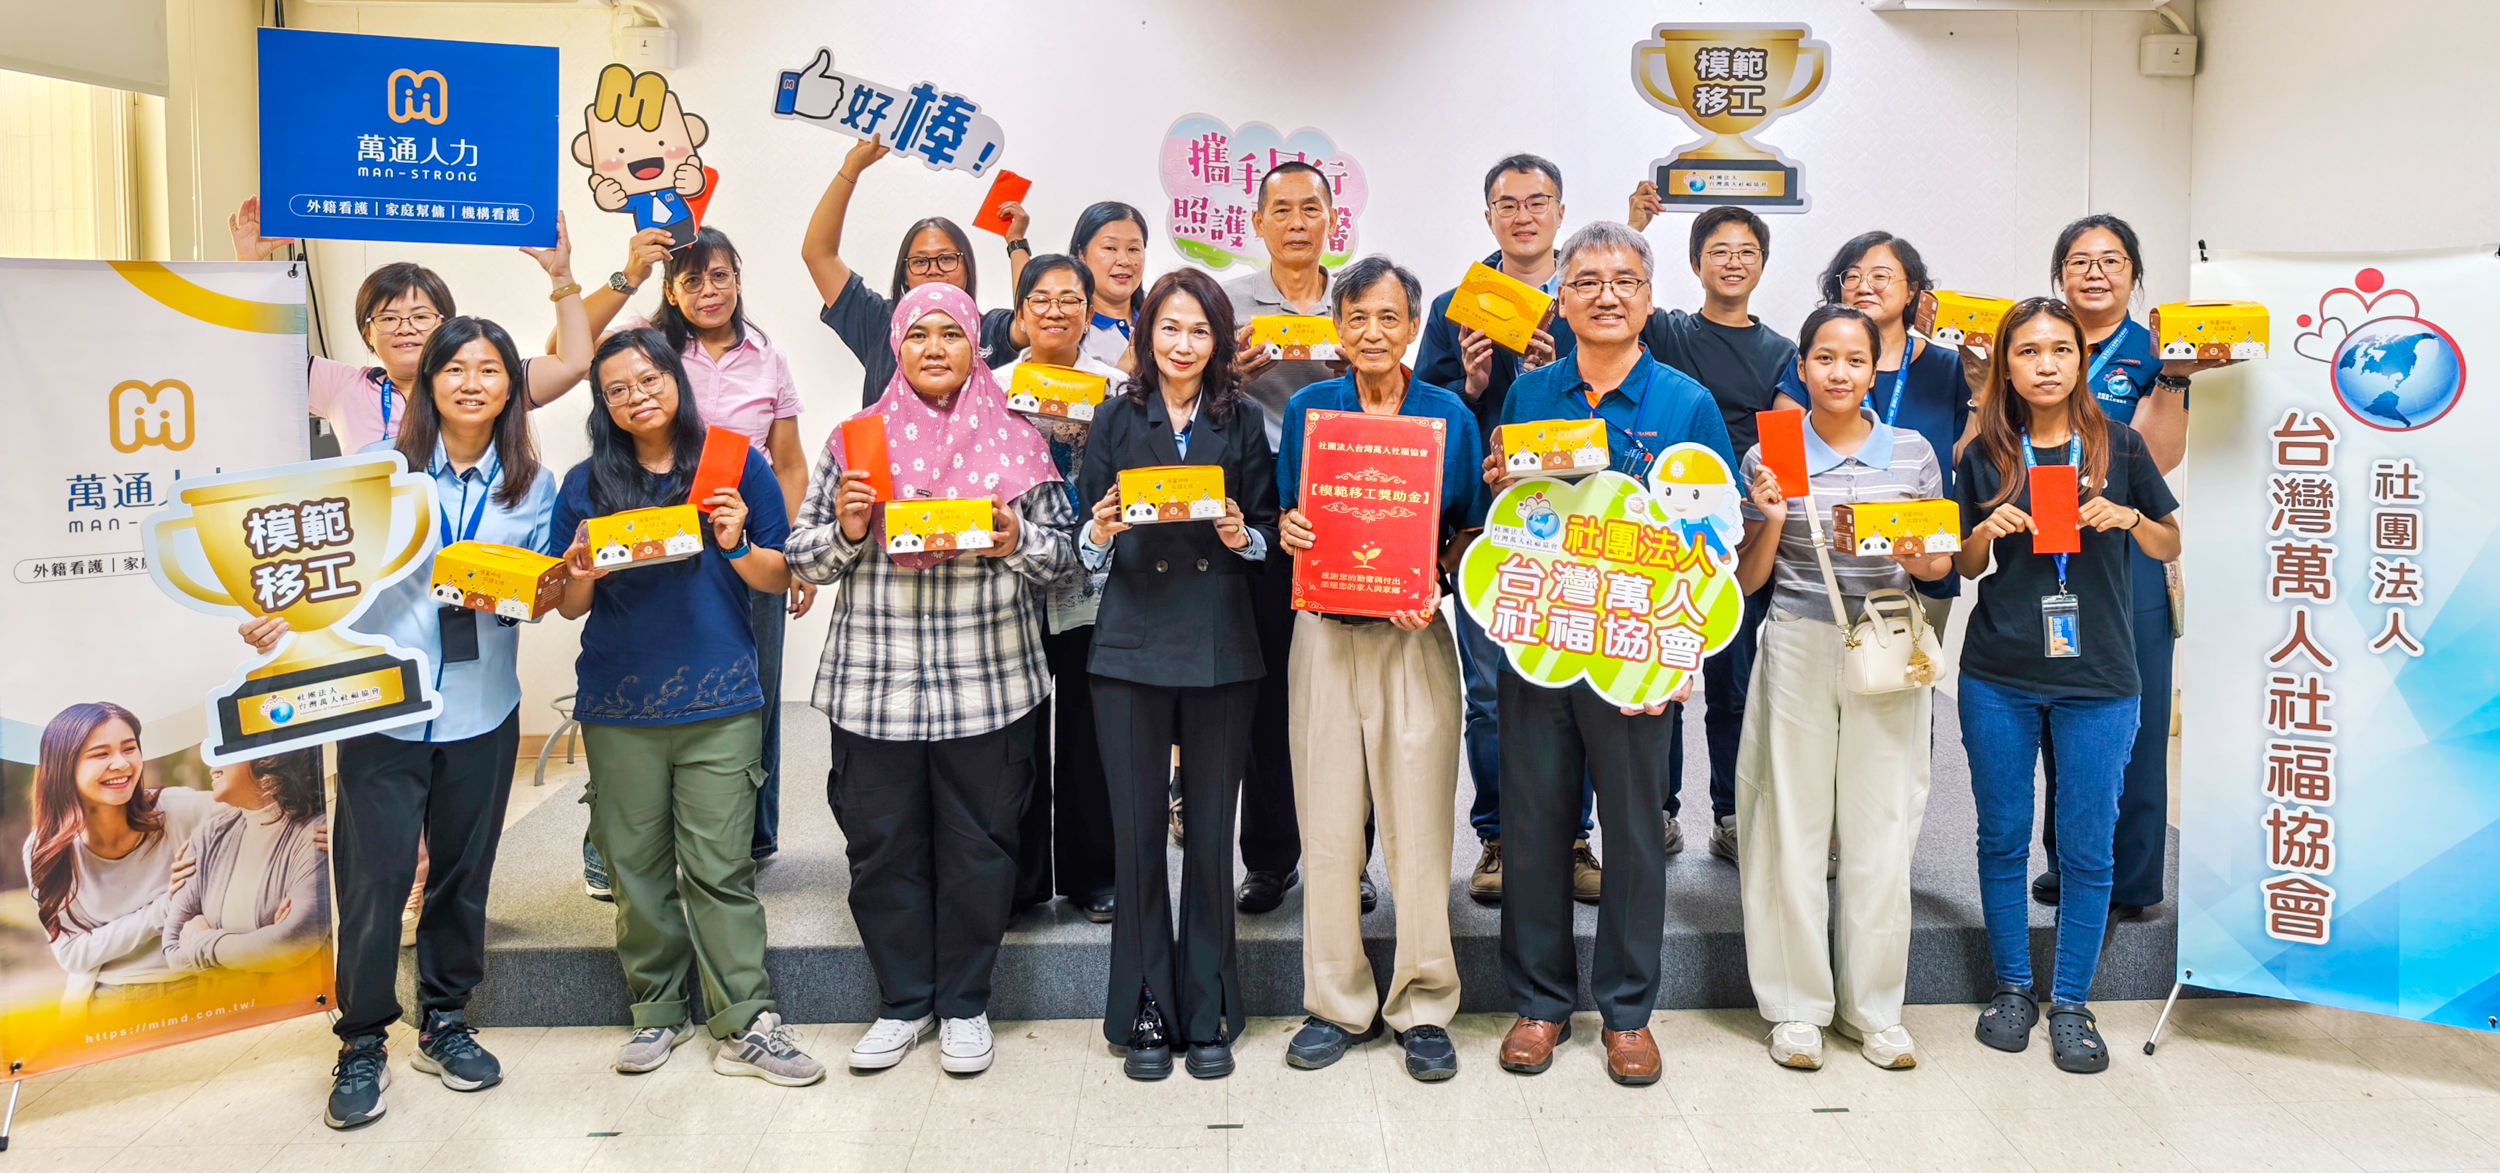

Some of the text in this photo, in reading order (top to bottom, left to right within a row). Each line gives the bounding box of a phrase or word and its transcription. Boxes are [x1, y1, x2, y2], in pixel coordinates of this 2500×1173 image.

[1697, 50, 1766, 79] 模範
[1696, 86, 1765, 115] 移工
[357, 134, 478, 167] 萬通人力
[307, 199, 521, 222] 外籍看護 家庭幫傭 機構看護
[1318, 441, 1429, 458] 社團法人台灣萬人社福協會
[248, 502, 350, 556] 模範
[1494, 525, 1526, 537] 社團法人
[1565, 516, 1715, 576] 社團法人
[2373, 463, 2420, 651] 社團法人
[33, 559, 104, 579] 外籍看護
[255, 556, 357, 609] 移工
[1498, 555, 1705, 625] 台灣萬人
[1492, 600, 1706, 669] 社福協會
[2266, 412, 2335, 939] 台灣萬人社福協會
[297, 687, 337, 701] 社團法人
[298, 687, 380, 710] 台灣萬人社福協會
[85, 999, 256, 1044] https://mimd.com.tw/
